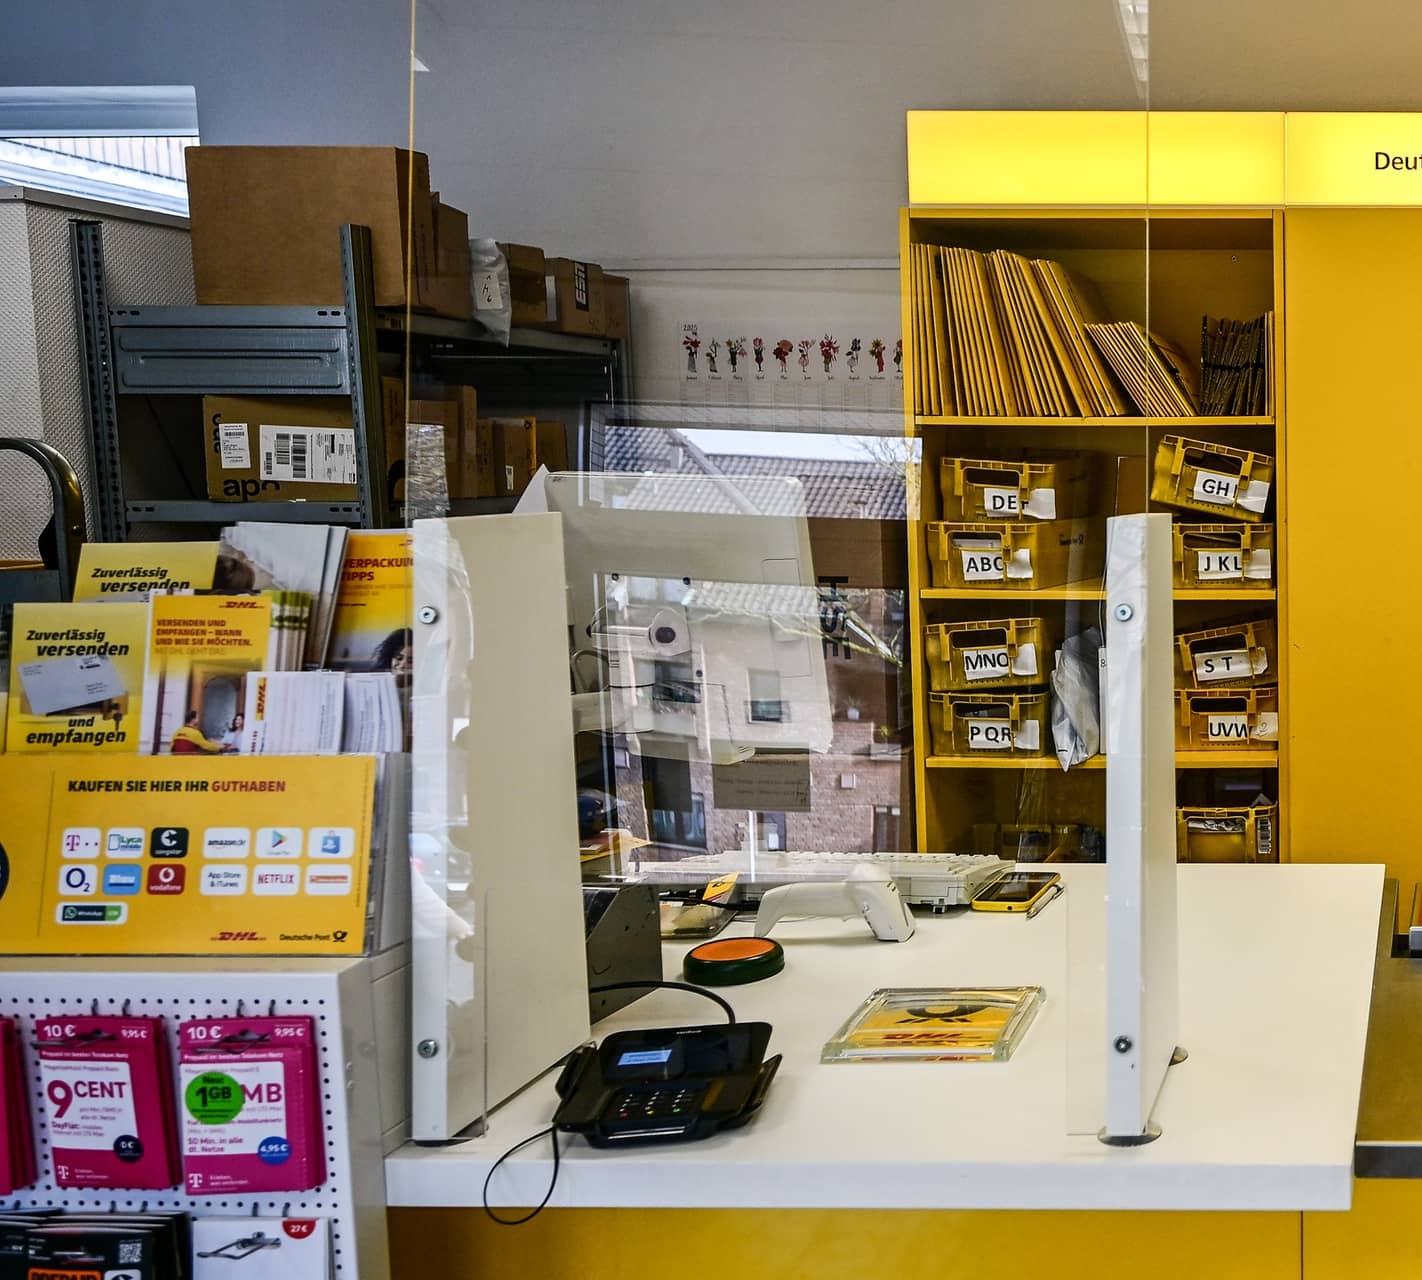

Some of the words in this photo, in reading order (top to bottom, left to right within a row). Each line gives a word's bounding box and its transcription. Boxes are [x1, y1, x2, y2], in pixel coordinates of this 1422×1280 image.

[966, 556, 1004, 573] ABC
[91, 567, 168, 581] Zuverlässig
[100, 580, 190, 593] versenden
[26, 629, 105, 642] Zuverlässig
[156, 628, 206, 636] EMPFANGEN
[37, 643, 129, 656] versenden
[965, 652, 1008, 671] MNO
[68, 716, 95, 727] und
[26, 729, 126, 747] empfangen
[68, 781, 122, 792] KAUFEN
[126, 781, 146, 792] SIE
[150, 781, 182, 792] HIER
[185, 781, 208, 792] IHR
[212, 781, 285, 792] GUTHABEN
[258, 874, 294, 884] NETFLIX
[219, 932, 258, 941] DHL
[43, 1025, 61, 1037] 10
[64, 1025, 76, 1037] €
[187, 1026, 207, 1039] 10
[210, 1026, 222, 1038] €
[48, 1080, 72, 1118] 9
[74, 1081, 126, 1098] CENT
